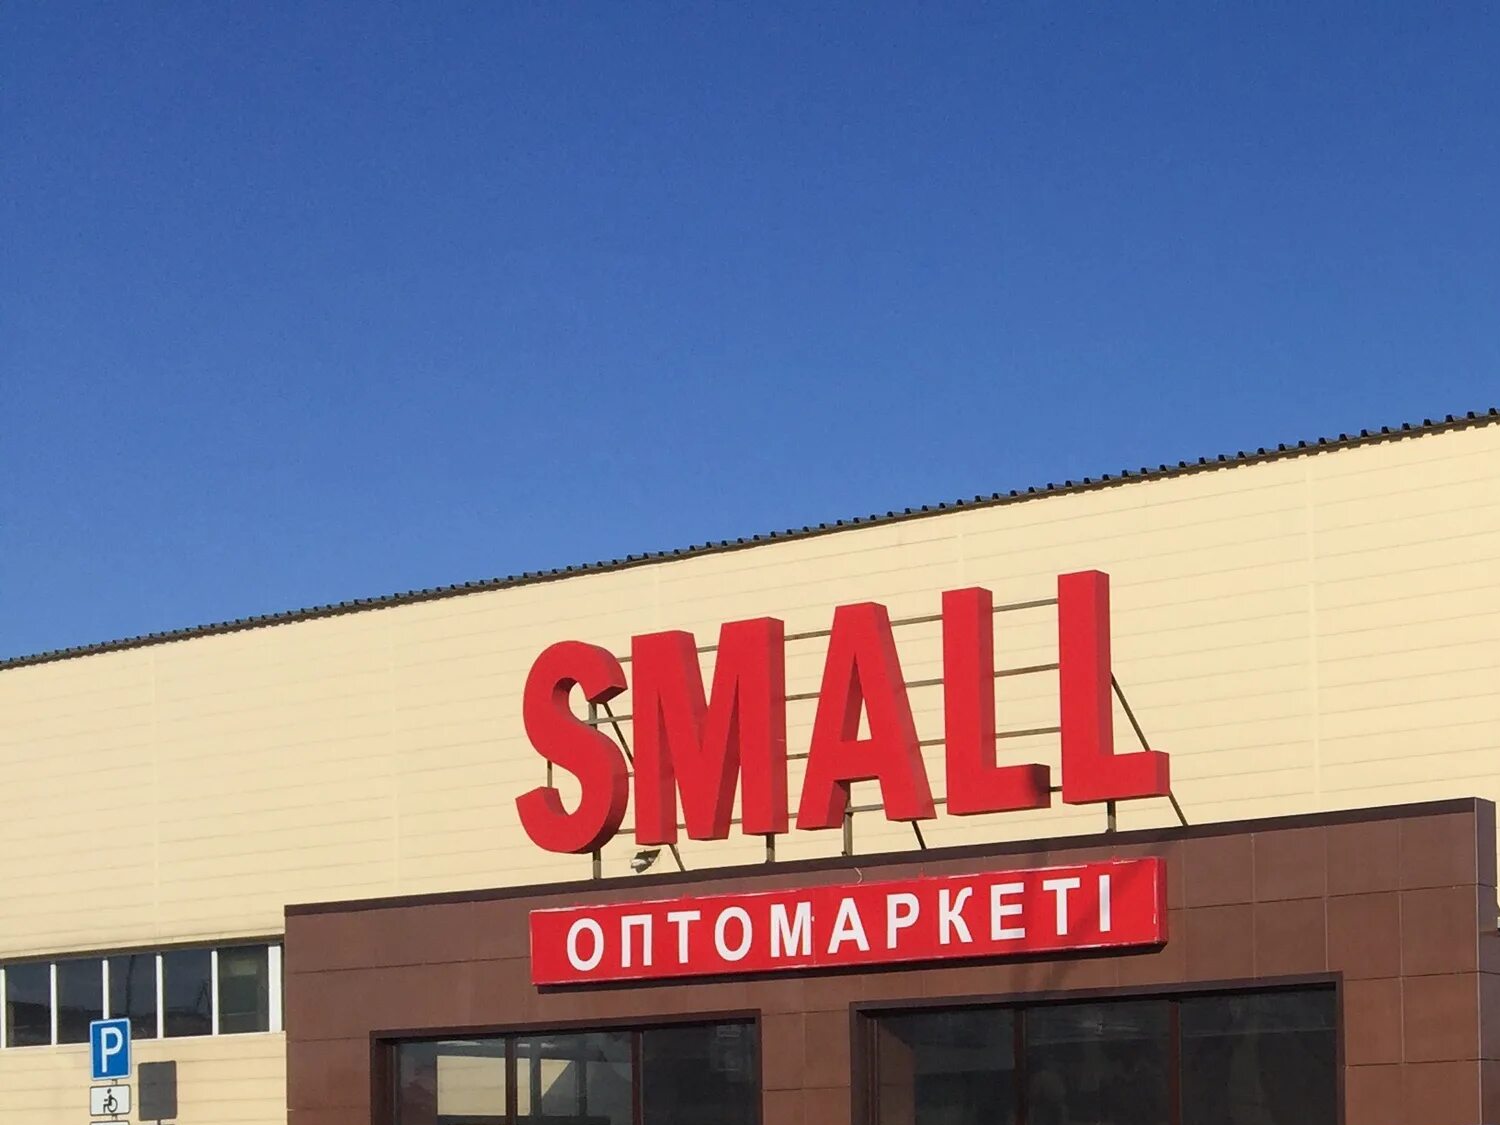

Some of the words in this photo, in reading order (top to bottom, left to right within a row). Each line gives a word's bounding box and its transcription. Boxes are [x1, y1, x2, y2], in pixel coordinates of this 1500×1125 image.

[516, 569, 1170, 854] SMALL
[566, 873, 1111, 972] ОПТОМАРКЕТІ
[101, 1026, 123, 1073] P
